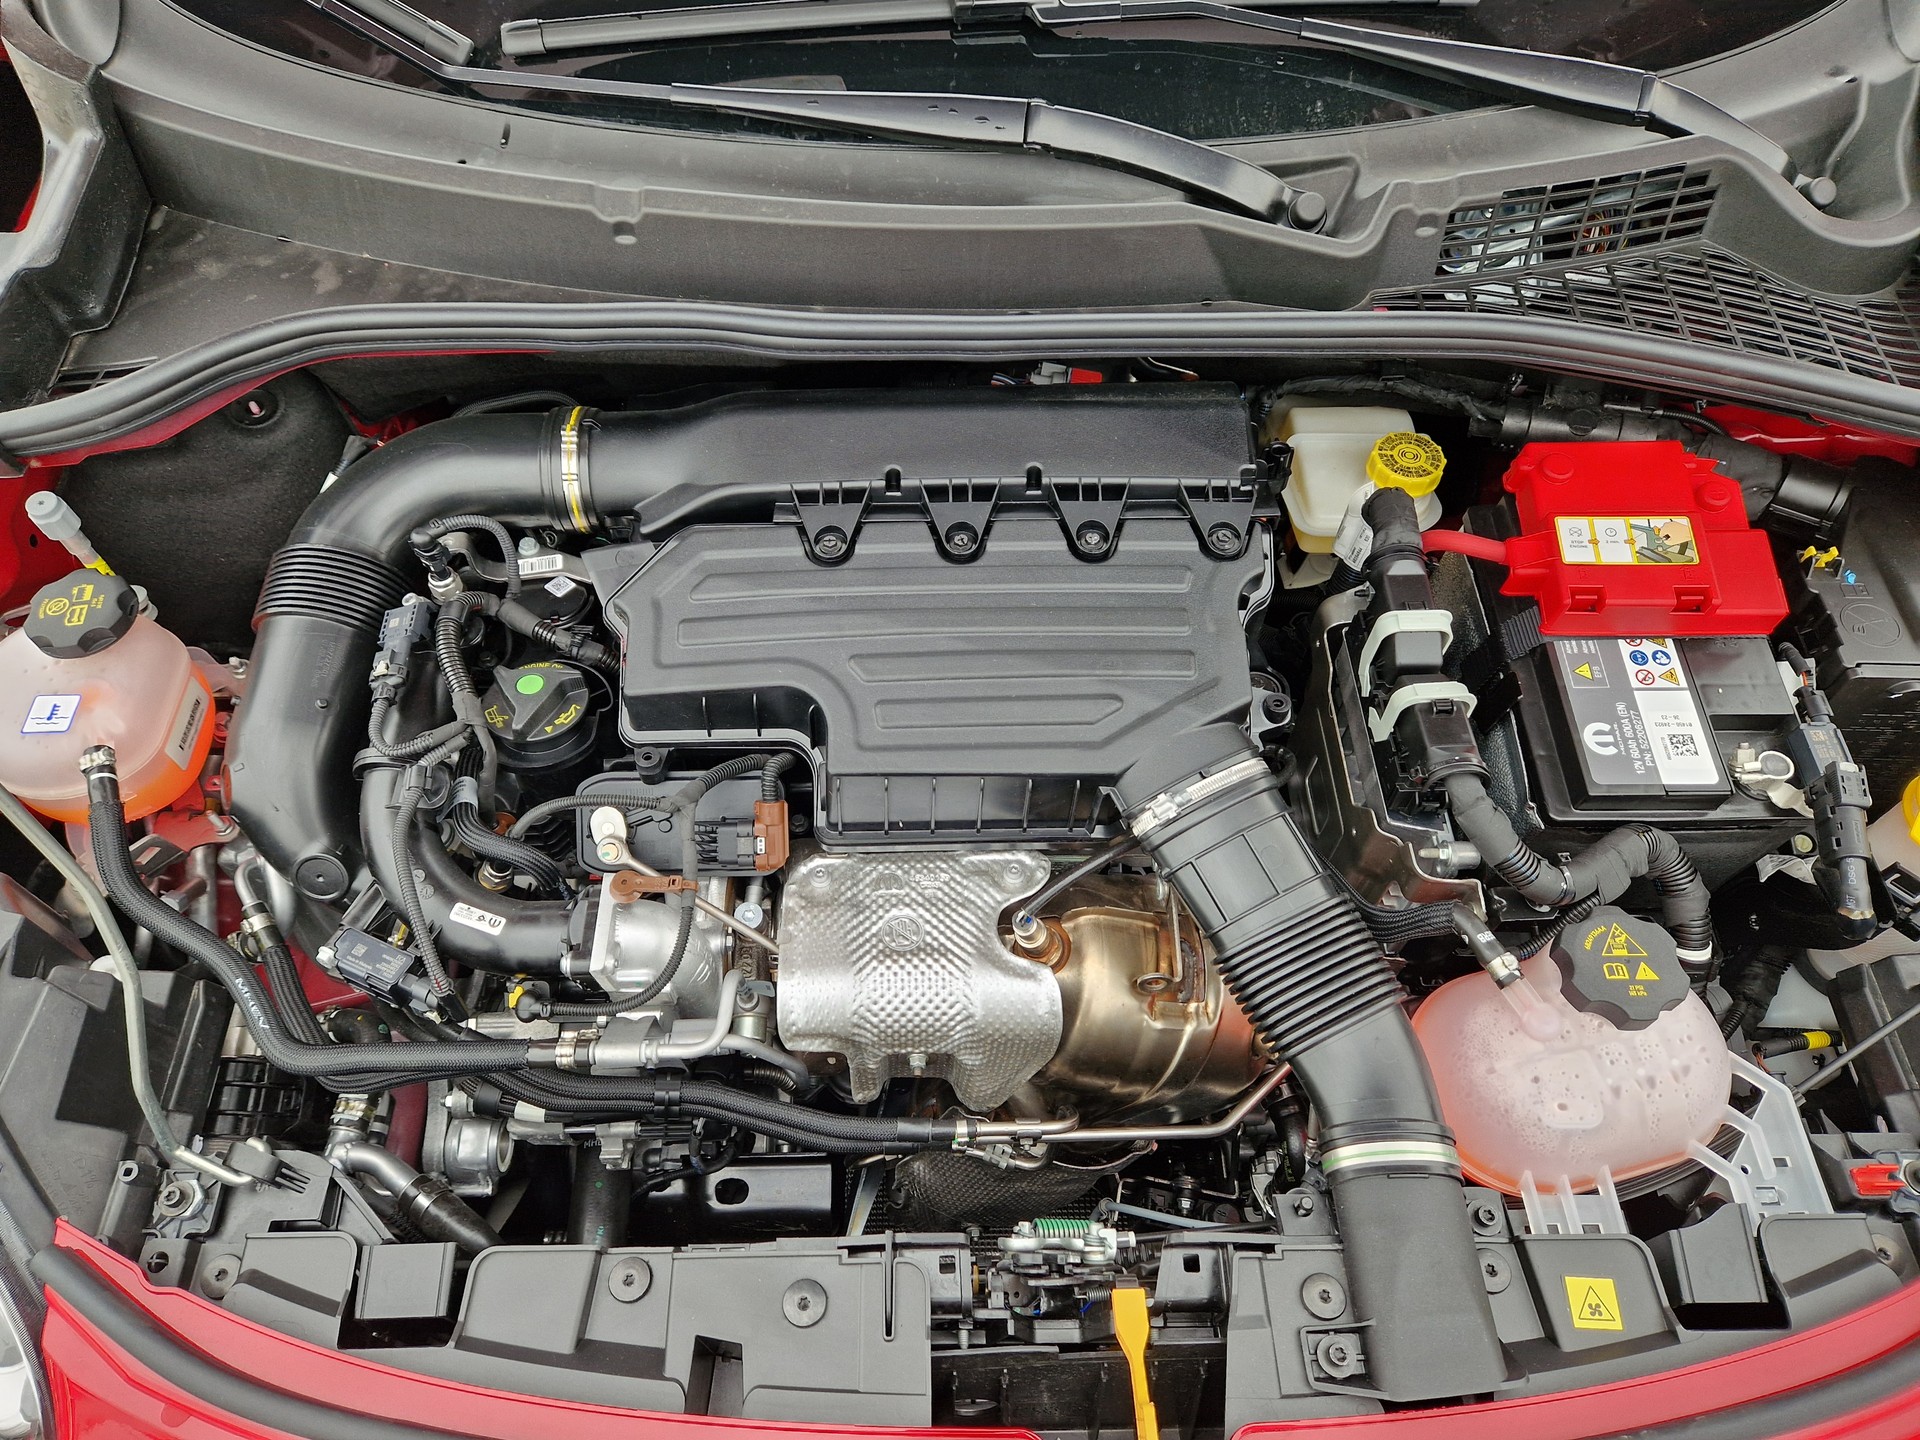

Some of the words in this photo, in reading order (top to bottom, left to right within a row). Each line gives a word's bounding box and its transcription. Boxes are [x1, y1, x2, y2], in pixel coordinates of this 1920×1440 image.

[1616, 701, 1628, 719] (EN)
[1623, 718, 1635, 738] 600A
[1632, 710, 1650, 752] 52206277
[1628, 738, 1641, 760] 60Ah
[1633, 760, 1645, 775] 12V
[1645, 754, 1656, 767] PN:
[1847, 866, 1857, 885] DSG
